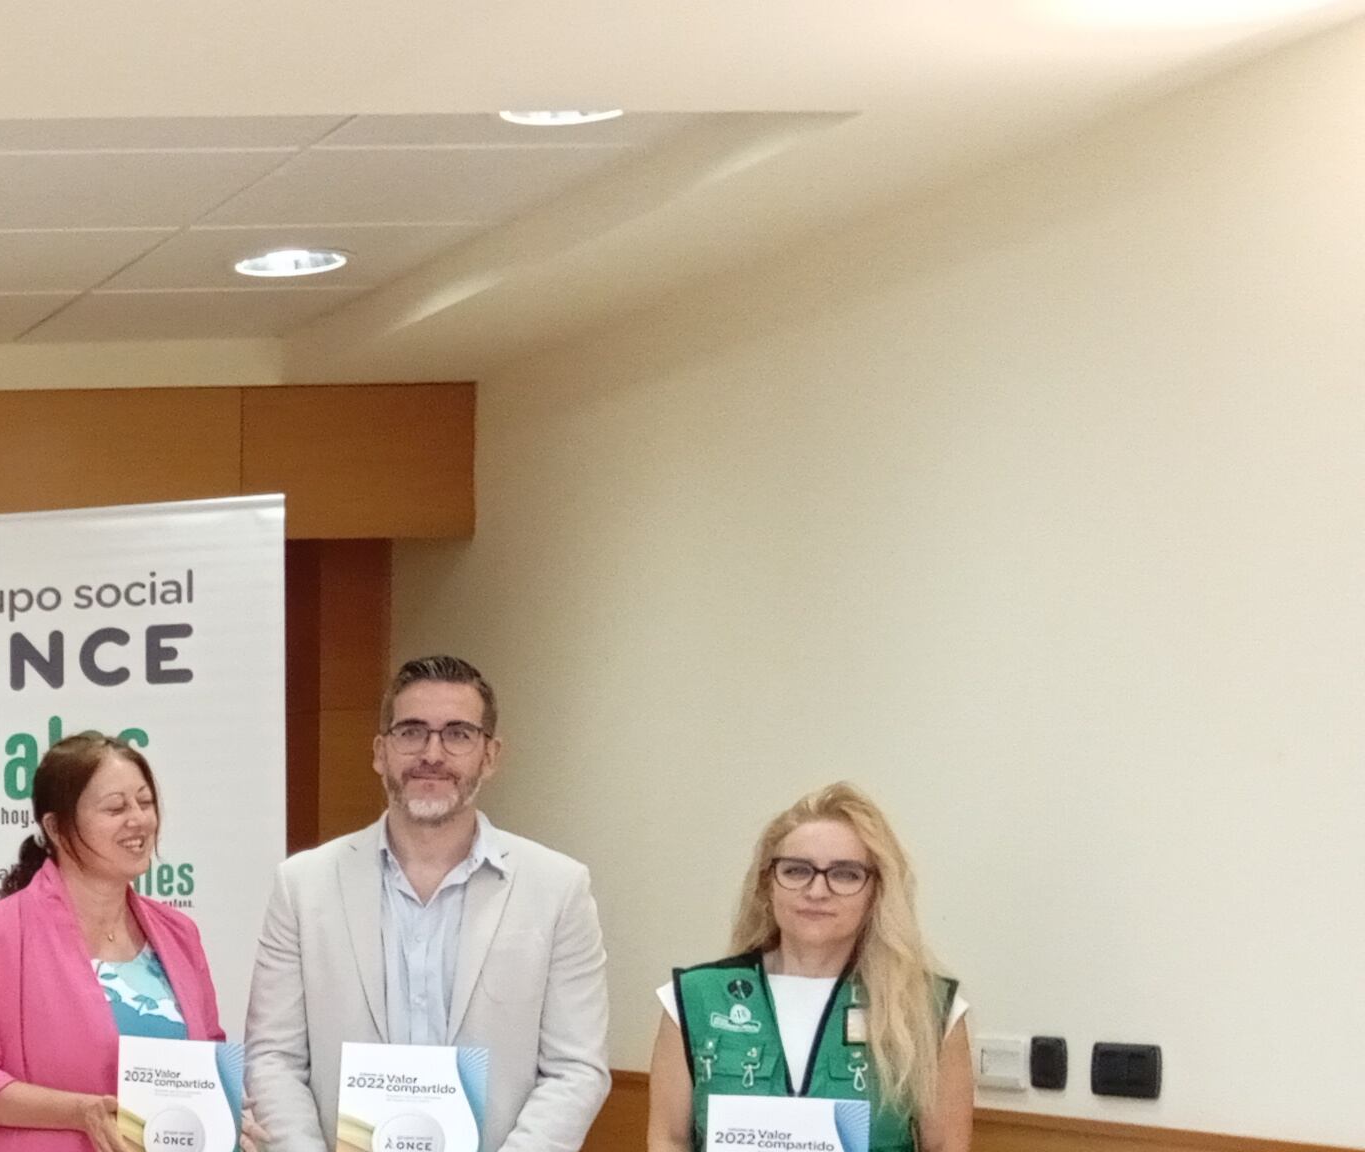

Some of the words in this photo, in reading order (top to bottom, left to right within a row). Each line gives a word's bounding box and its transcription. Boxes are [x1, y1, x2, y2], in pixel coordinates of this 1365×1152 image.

[74, 569, 194, 608] social
[124, 1070, 153, 1083] 2022
[154, 1069, 181, 1079] Valor
[347, 1076, 385, 1089] 2022
[386, 1074, 418, 1084] Valor
[154, 1078, 215, 1090] compartido
[386, 1084, 457, 1094] compartido
[163, 1137, 194, 1146] ONCE
[715, 1131, 756, 1145] 2022
[757, 1129, 792, 1140] Valor
[396, 1141, 432, 1151] ONCE
[757, 1140, 835, 1152] compartido
